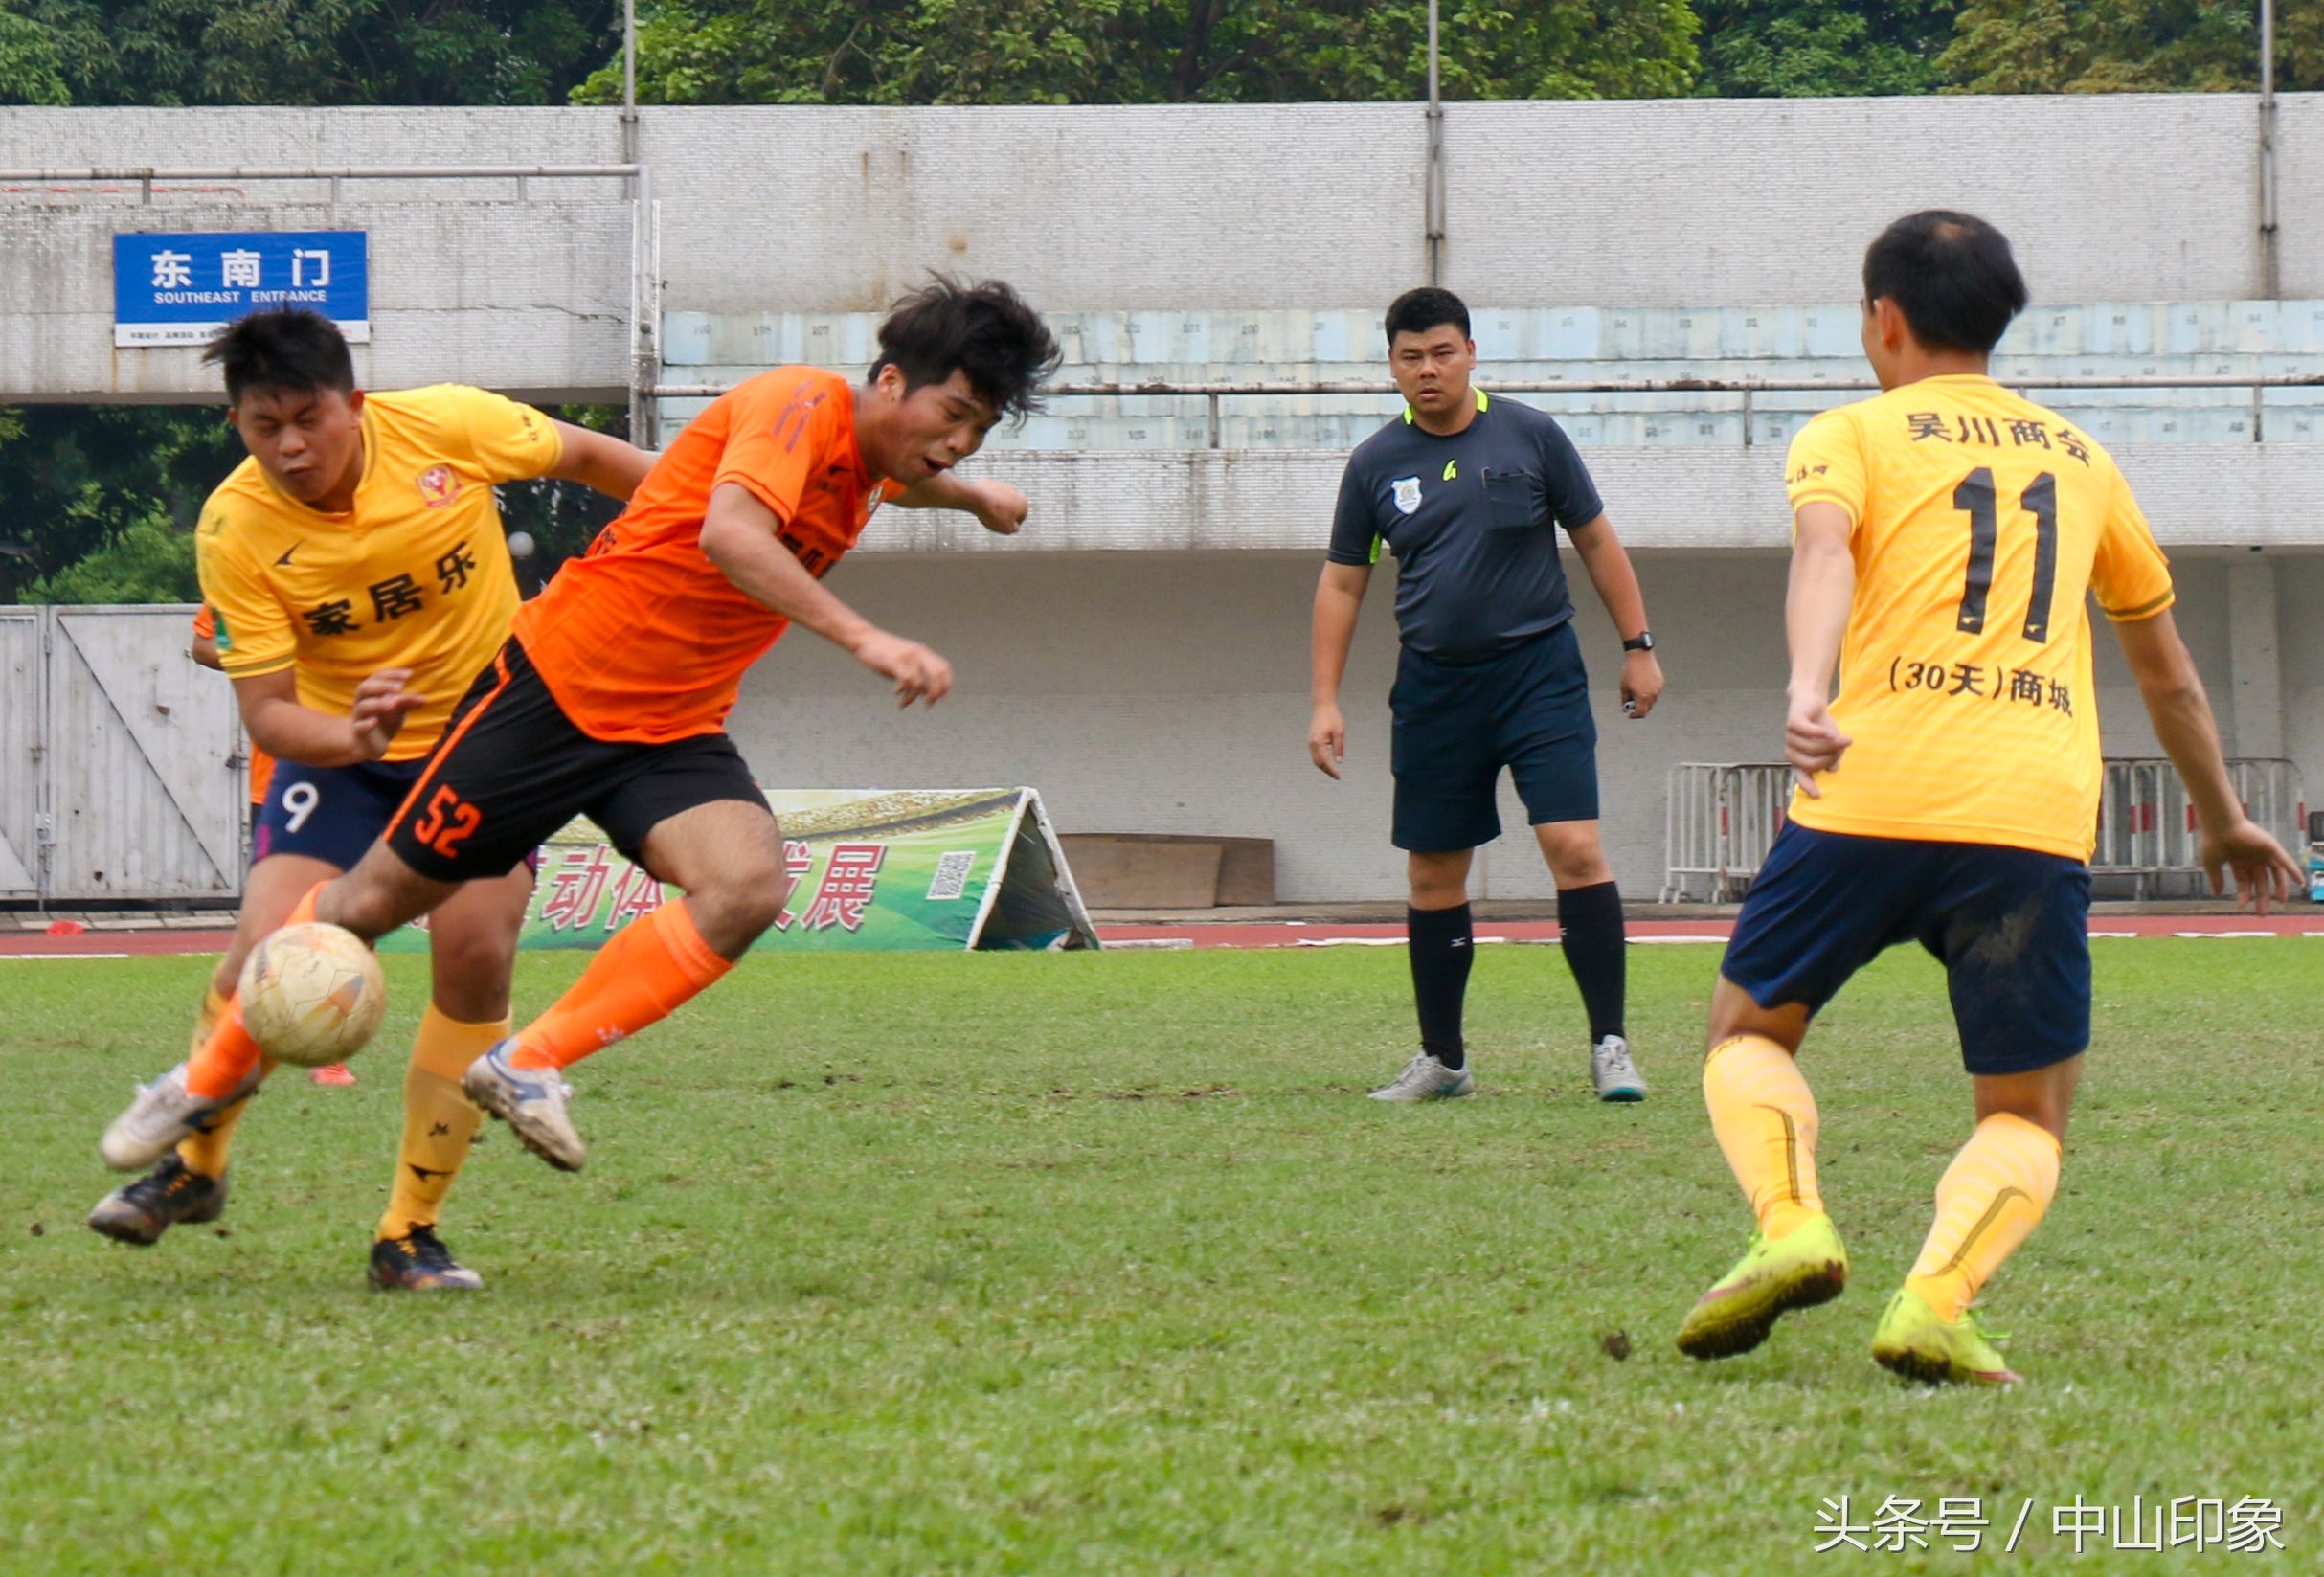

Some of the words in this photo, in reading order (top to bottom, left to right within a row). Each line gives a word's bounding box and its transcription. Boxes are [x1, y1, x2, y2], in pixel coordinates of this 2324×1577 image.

[151, 249, 330, 288] 东南门
[154, 291, 240, 304] SOUTHEAST
[251, 290, 327, 303] ENTRANCE
[1907, 412, 2091, 468] 吴川商会
[1952, 465, 2058, 644] 11
[301, 541, 476, 636] 家居乐
[282, 781, 320, 834] 9
[414, 783, 483, 859] 52
